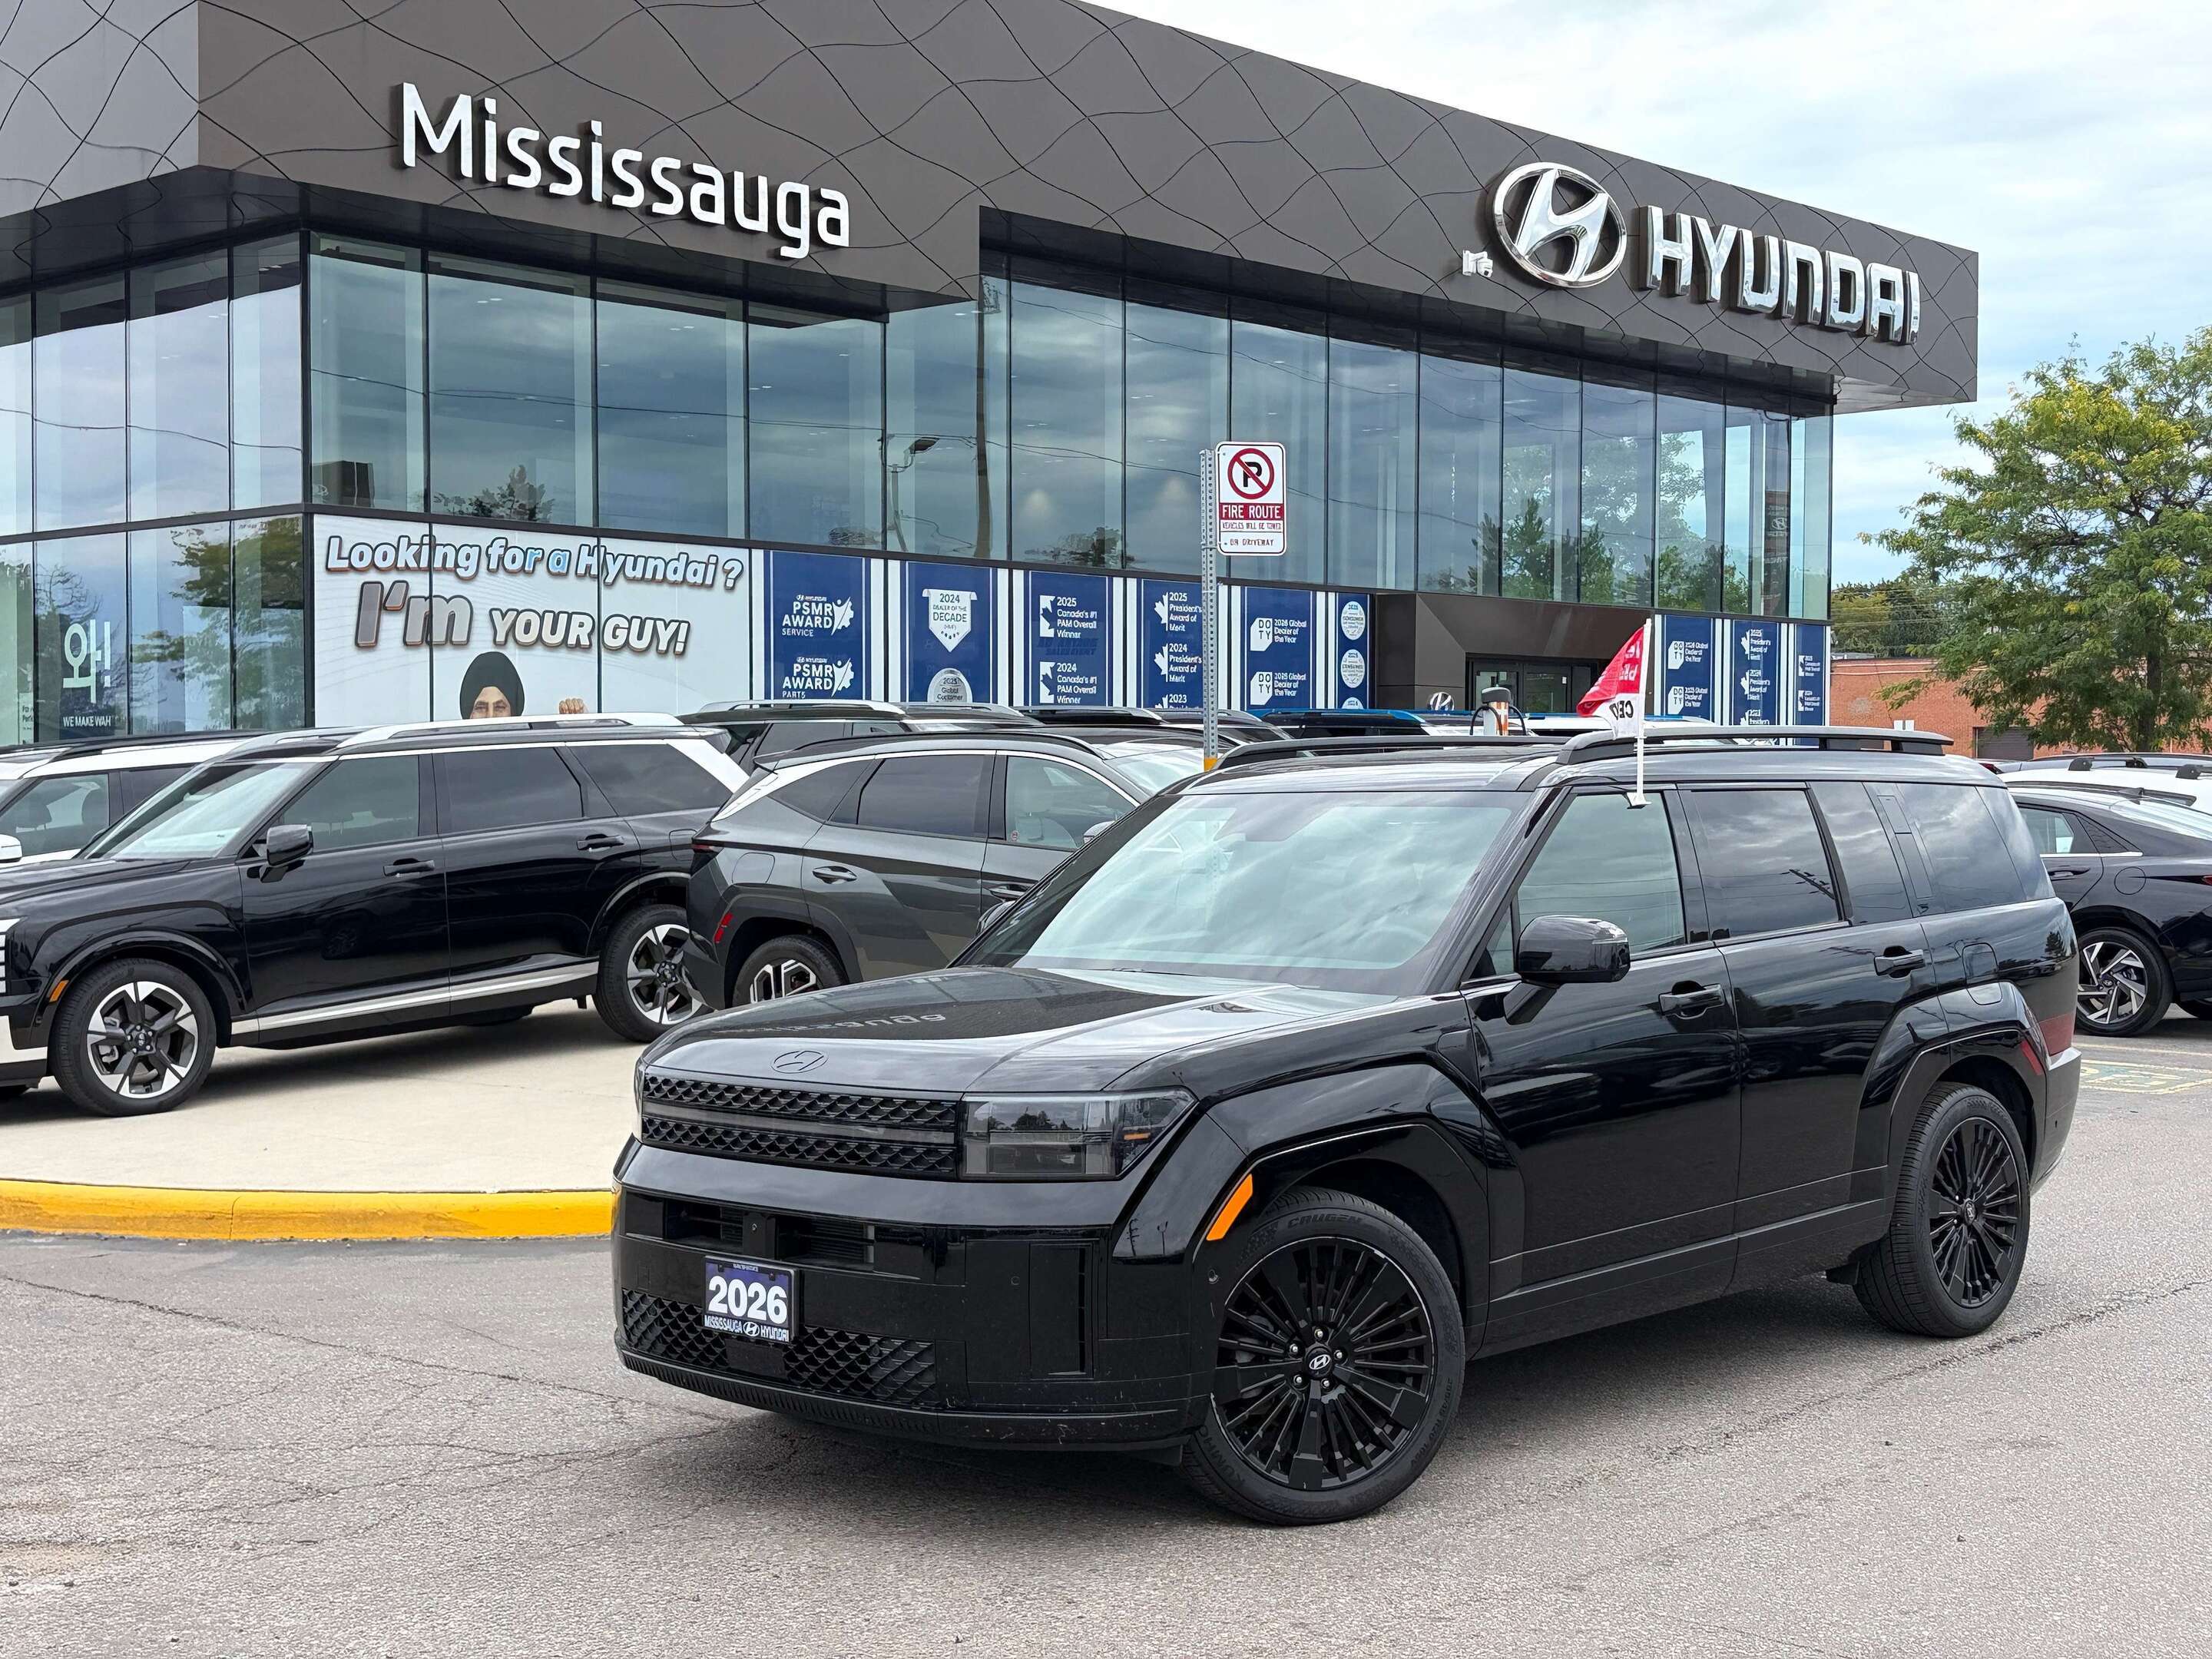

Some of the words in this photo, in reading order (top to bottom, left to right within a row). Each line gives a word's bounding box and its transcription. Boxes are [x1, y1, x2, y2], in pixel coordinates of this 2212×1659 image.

[399, 81, 850, 260] Mississauga
[1644, 205, 1921, 346] HYUNDAI
[1222, 504, 1244, 518] FIRE
[1249, 505, 1281, 519] ROUTE
[326, 535, 482, 580] Looking
[486, 537, 545, 572] for
[548, 548, 571, 575] a
[576, 544, 718, 587] Hyundai
[939, 593, 960, 603] 2024
[1169, 592, 1187, 601] 2025
[1057, 597, 1077, 607] 2025
[793, 601, 833, 616] PSMR
[355, 580, 474, 647] I'm
[488, 608, 596, 649] YOUR
[601, 614, 691, 655] GUY!
[932, 612, 968, 623] DECADE
[1057, 609, 1089, 619] Canada's
[783, 614, 833, 629] AWARD
[1073, 620, 1098, 629] Overall
[782, 628, 814, 637] SERVICE
[1057, 629, 1081, 638] Winner
[1169, 644, 1187, 653] 2024
[793, 663, 833, 677] PSMR
[1057, 663, 1077, 673] 2024
[783, 676, 833, 690] AWARD
[1057, 675, 1088, 684] Canada's
[782, 690, 806, 699] PARTS
[1073, 685, 1097, 694] Overall
[1057, 695, 1081, 704] Winner
[1169, 694, 1187, 704] 2023
[63, 717, 75, 727] WE
[75, 716, 94, 727] MAKE
[94, 716, 111, 727] WAH
[708, 1275, 788, 1324] 2026
[704, 1314, 743, 1333] MISSISSAUGA
[760, 1325, 790, 1342] HYUNDAI
